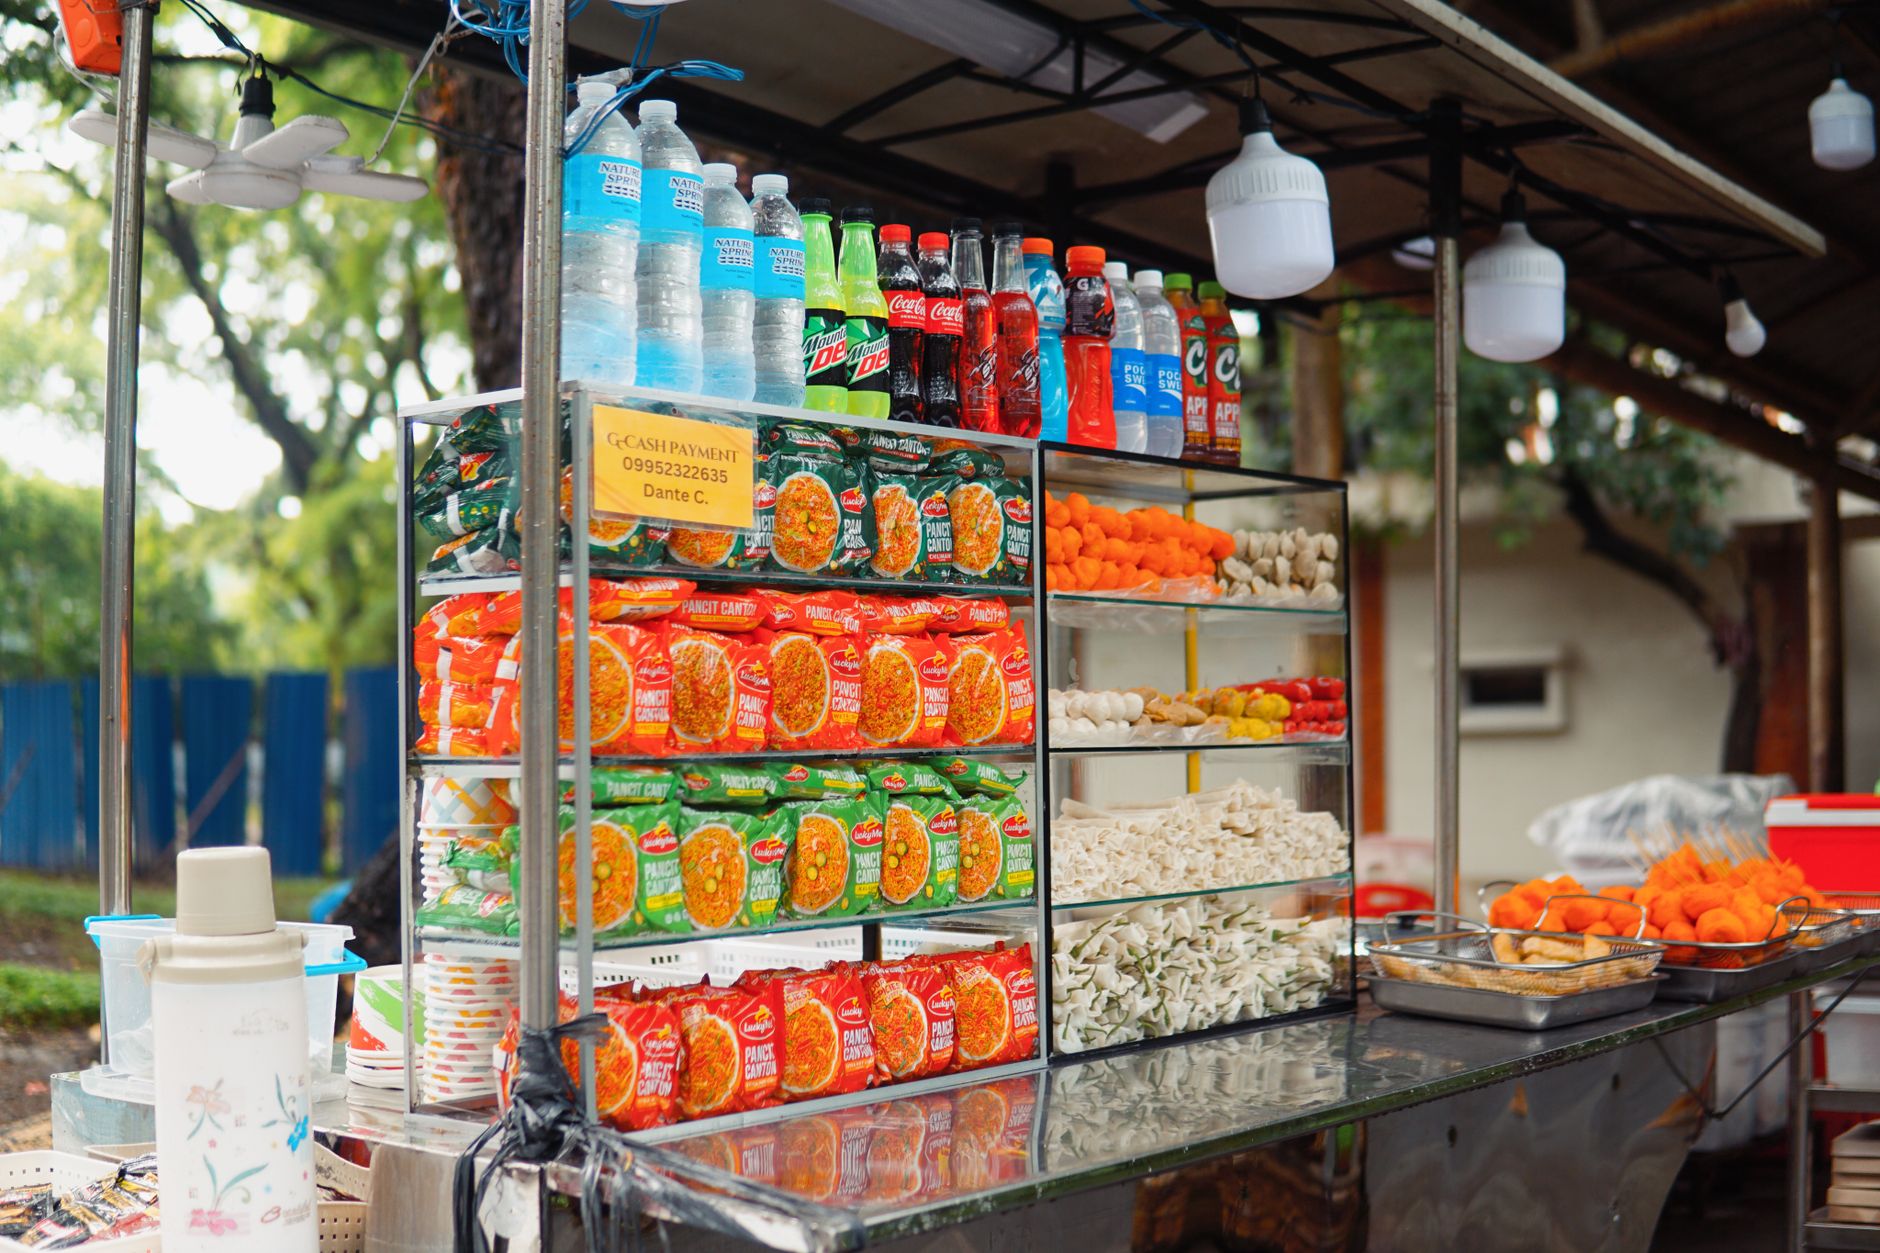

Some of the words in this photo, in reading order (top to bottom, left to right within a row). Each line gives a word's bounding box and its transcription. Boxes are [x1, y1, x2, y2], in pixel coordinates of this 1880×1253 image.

[669, 441, 739, 464] PAYMENT
[623, 456, 728, 484] 09952322635
[643, 483, 689, 503] Dante
[694, 490, 709, 505] C.
[681, 599, 718, 614] PANCIT
[841, 1007, 862, 1019] Lucky
[744, 1061, 777, 1080] CANTON
